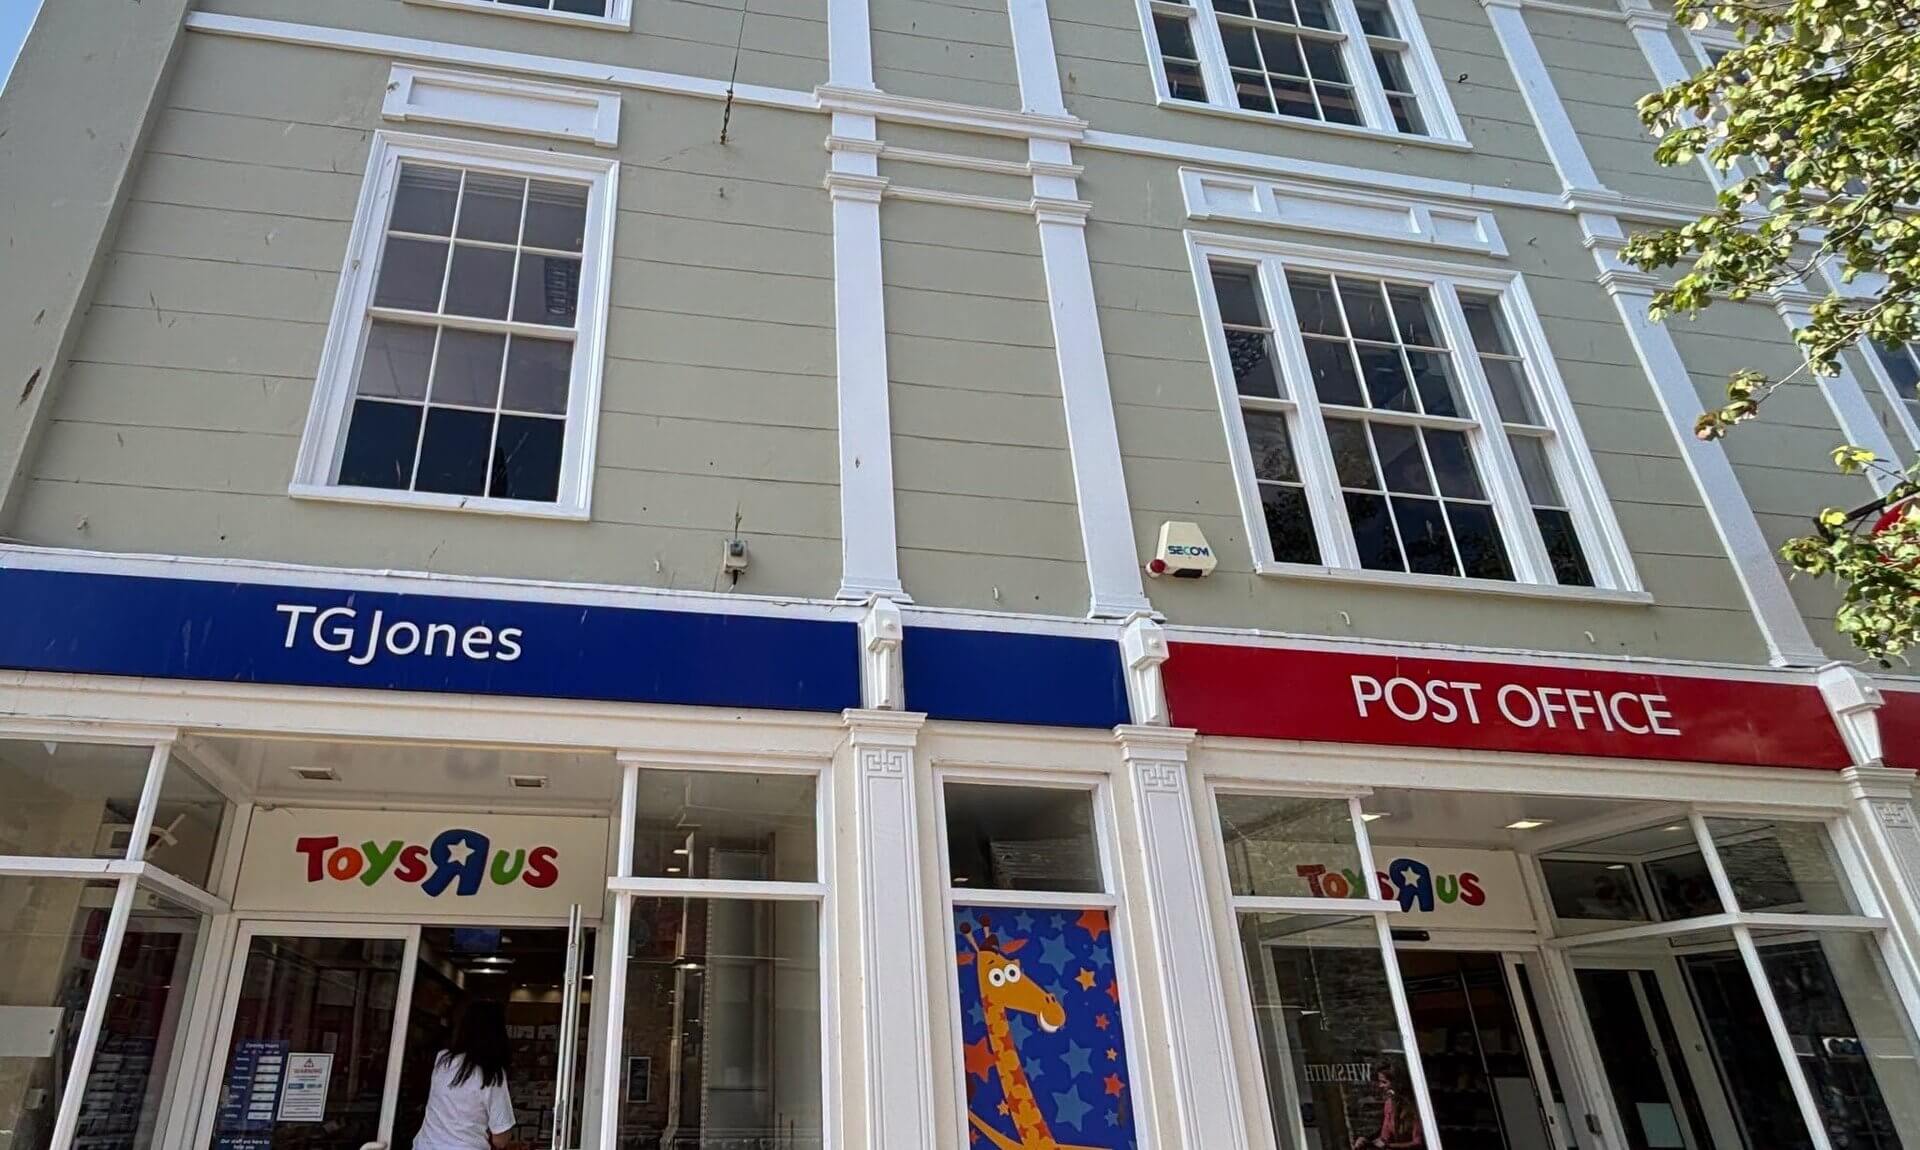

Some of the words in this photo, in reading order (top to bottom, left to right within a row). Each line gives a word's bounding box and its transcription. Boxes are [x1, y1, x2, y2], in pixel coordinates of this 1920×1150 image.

[1168, 545, 1209, 557] SECOM
[1350, 674, 1482, 724] POST
[1497, 684, 1682, 736] OFFICE
